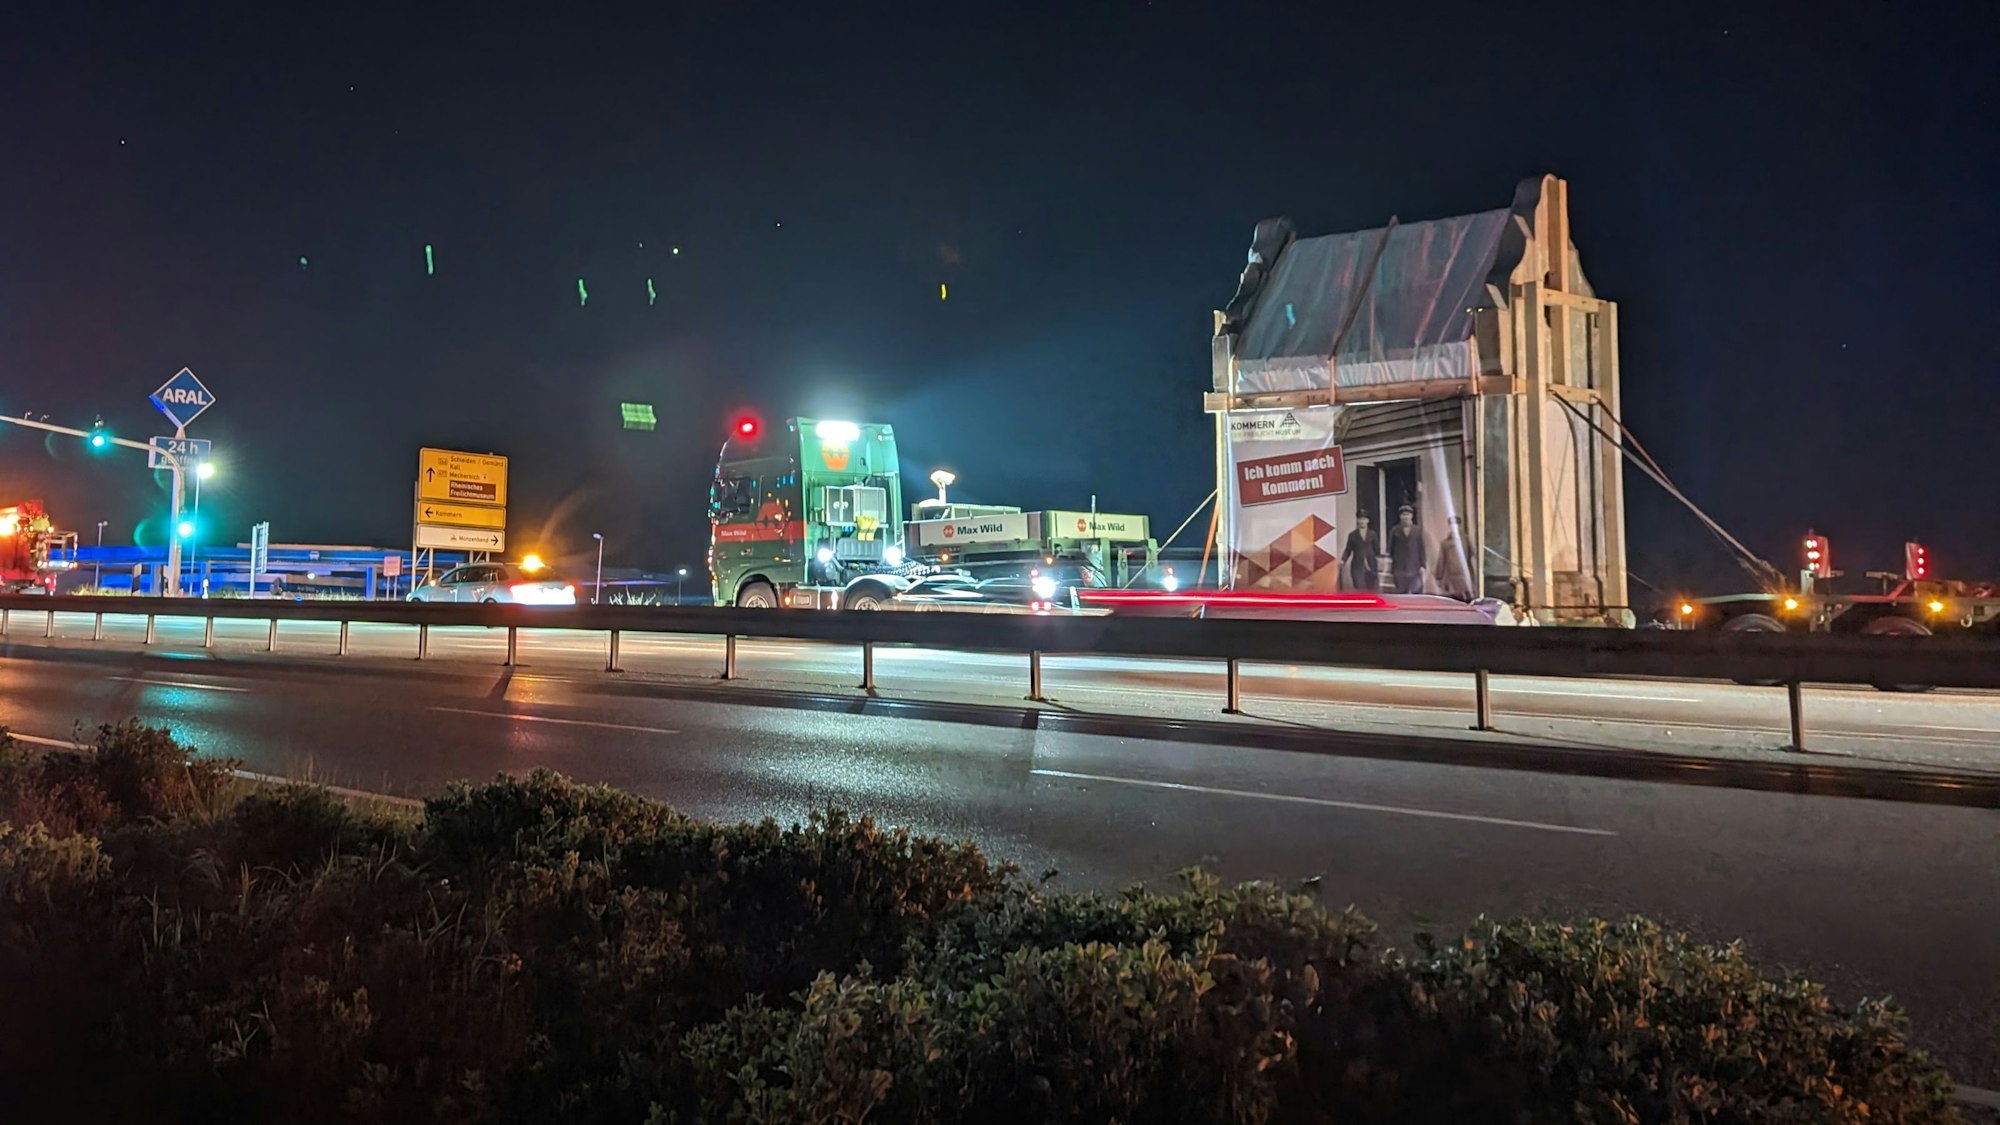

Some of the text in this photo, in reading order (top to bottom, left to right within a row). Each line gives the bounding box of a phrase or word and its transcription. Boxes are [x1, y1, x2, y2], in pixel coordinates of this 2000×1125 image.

[163, 388, 207, 405] ARAL
[1231, 420, 1275, 431] KOMMERN
[168, 440, 198, 455] 24 h
[1244, 455, 1335, 480] Ich komm nach
[450, 482, 483, 491] Rheinisches
[1261, 475, 1324, 496] Kommern!
[450, 490, 495, 499] Freilichtmuseum
[957, 524, 1003, 535] Max Wild
[1089, 521, 1125, 532] Max Wild
